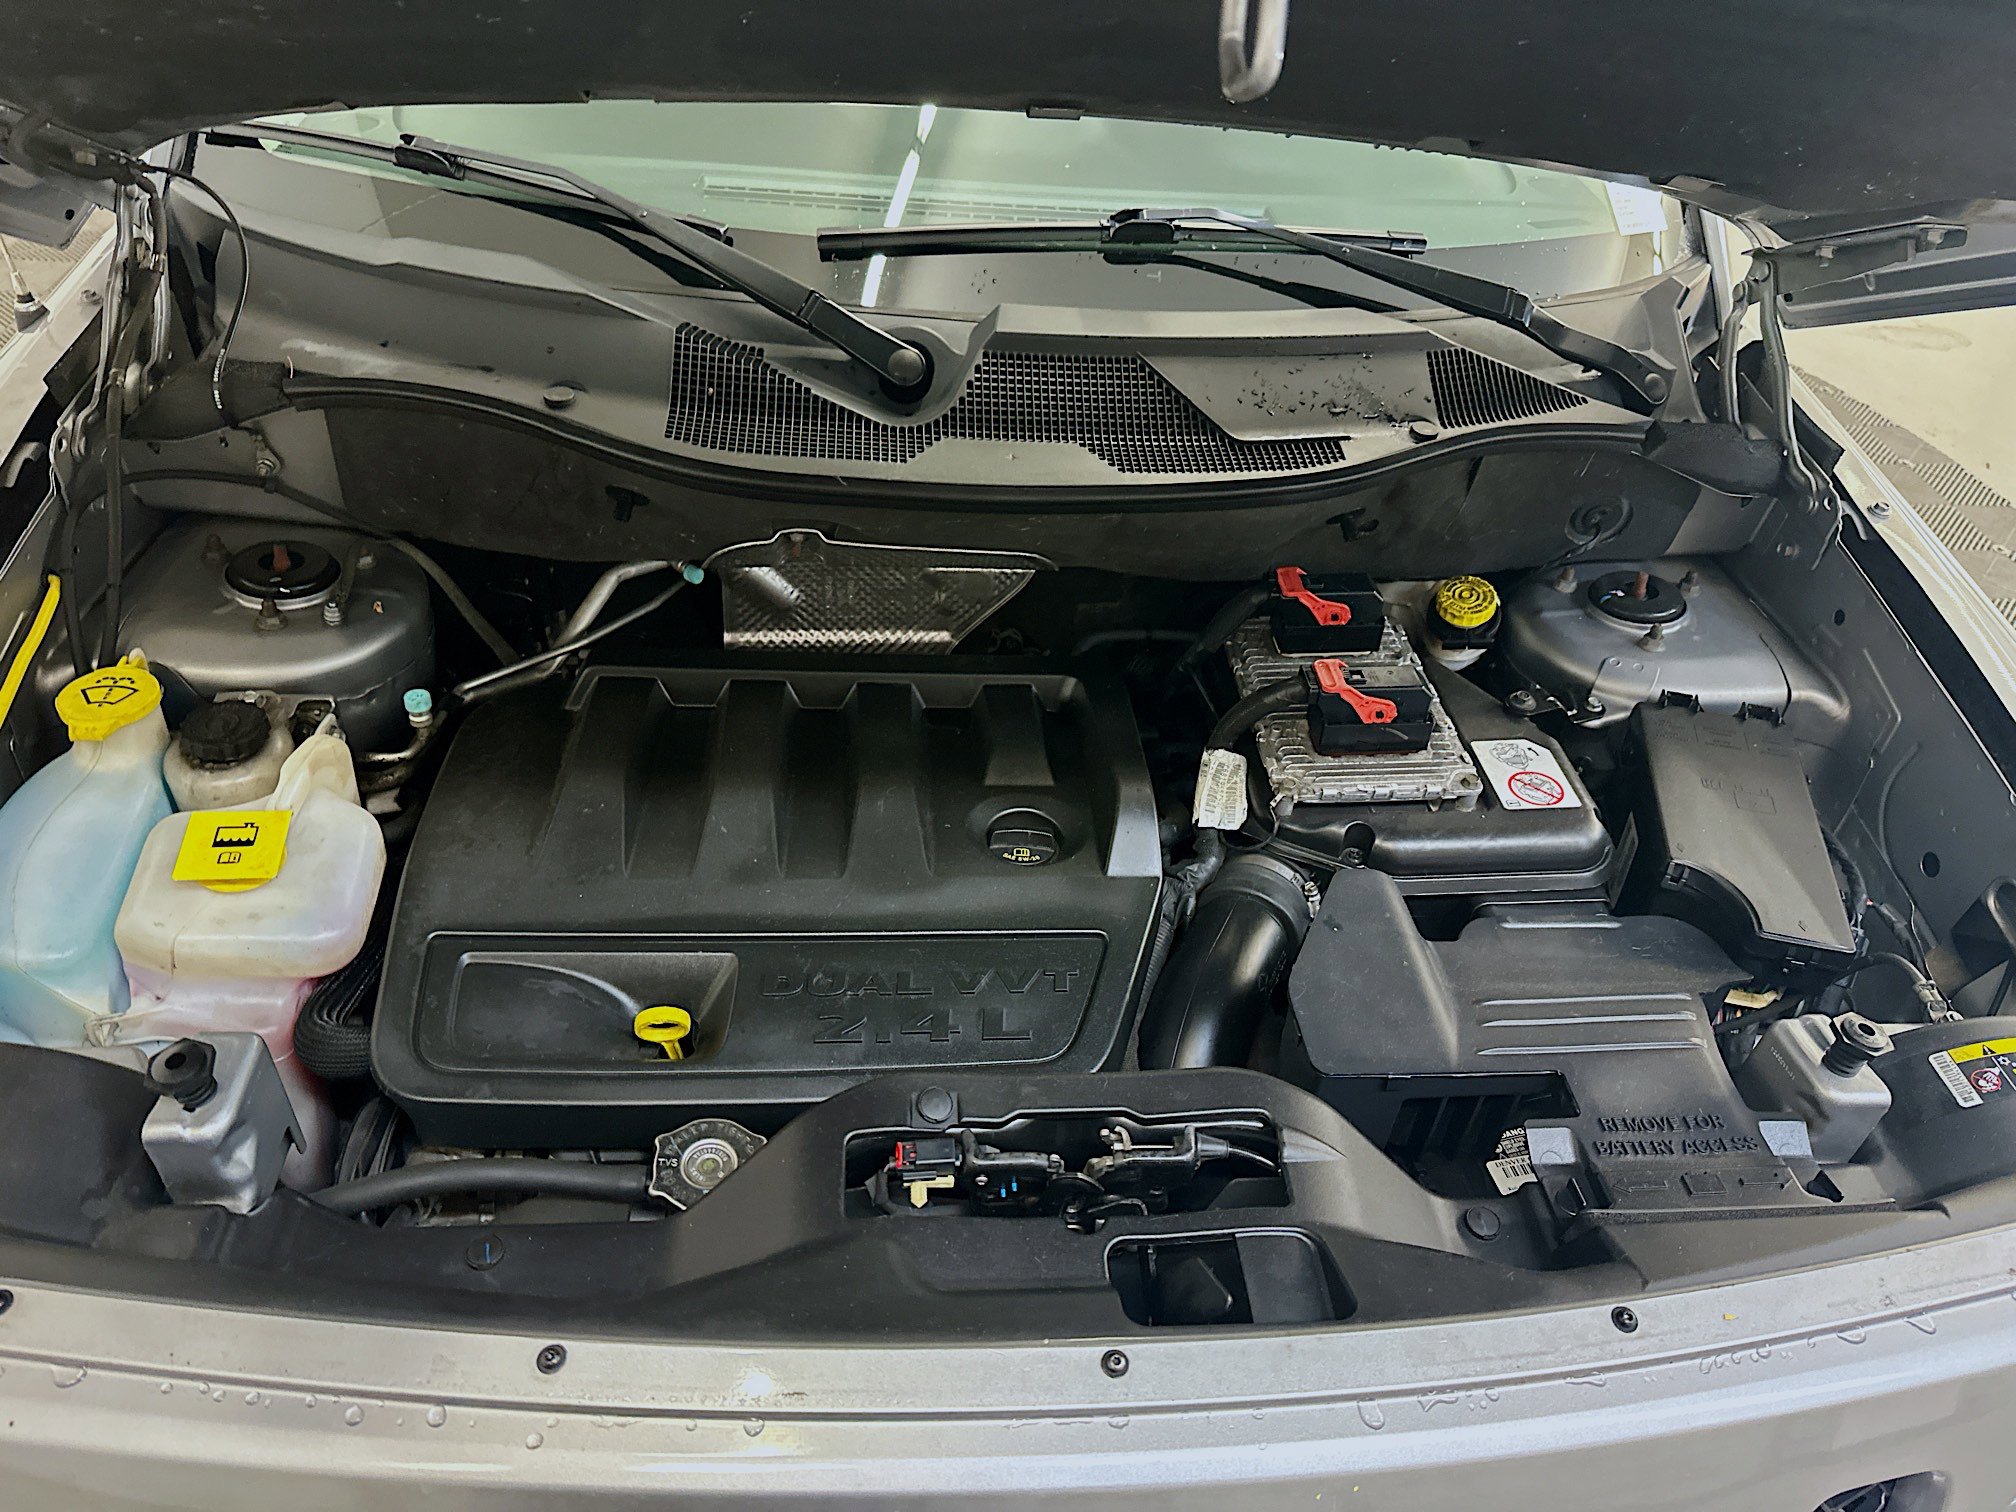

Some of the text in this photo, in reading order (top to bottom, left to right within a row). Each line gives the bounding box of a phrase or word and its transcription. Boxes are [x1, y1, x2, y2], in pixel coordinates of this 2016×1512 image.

[762, 968, 1080, 997] DUAL VVT
[1598, 1111, 1727, 1133] REMOVE FOR
[1593, 1135, 1760, 1157] BATTERY ACCESS
[657, 1158, 679, 1168] TVS
[1494, 1157, 1527, 1168] DENVER
